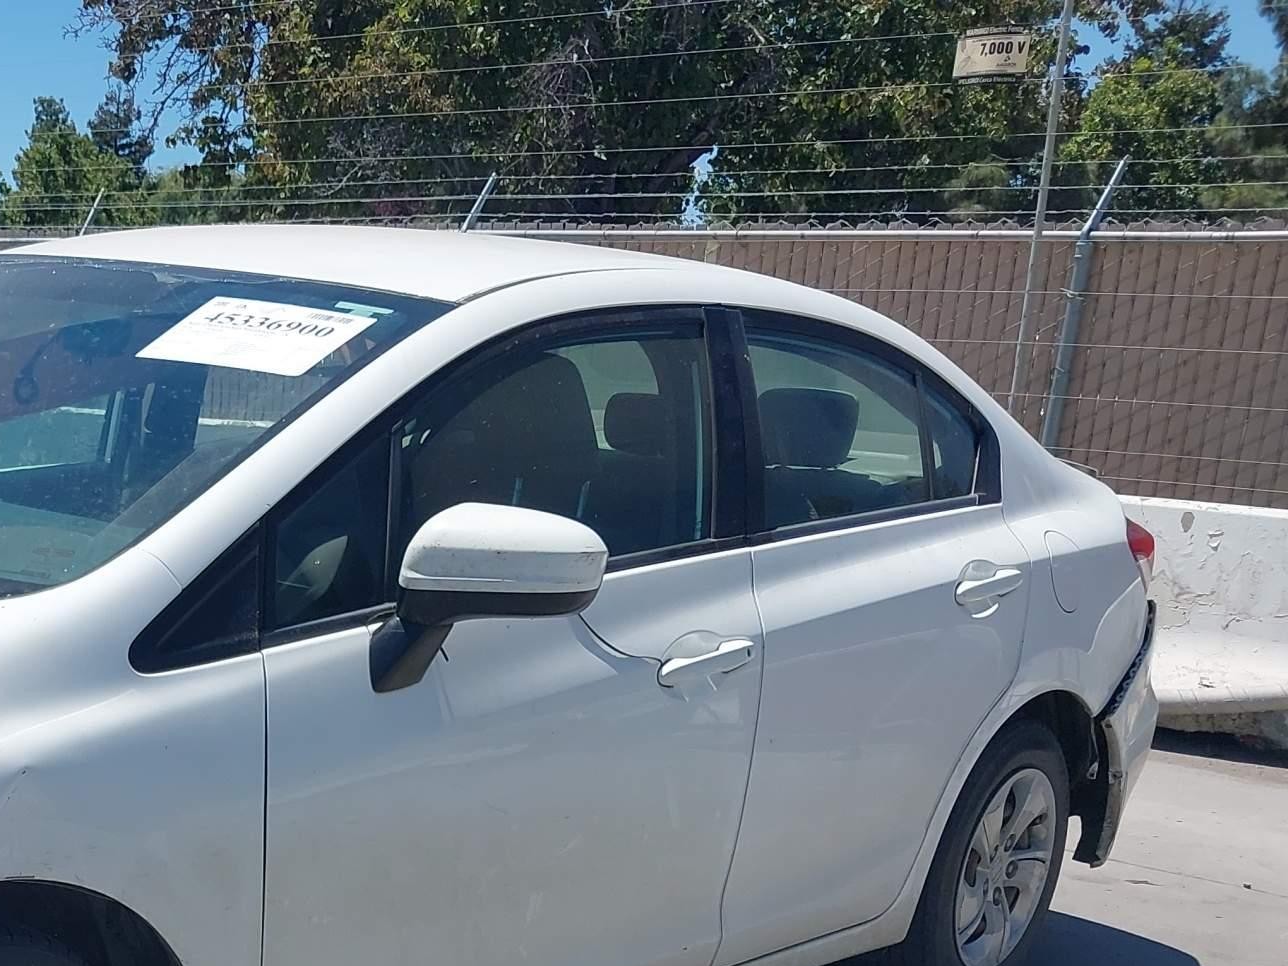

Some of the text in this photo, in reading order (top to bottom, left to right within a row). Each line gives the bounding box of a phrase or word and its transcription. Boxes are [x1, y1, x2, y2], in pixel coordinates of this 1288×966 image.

[980, 41, 1026, 56] 7,000 V
[204, 312, 335, 338] 45336900
